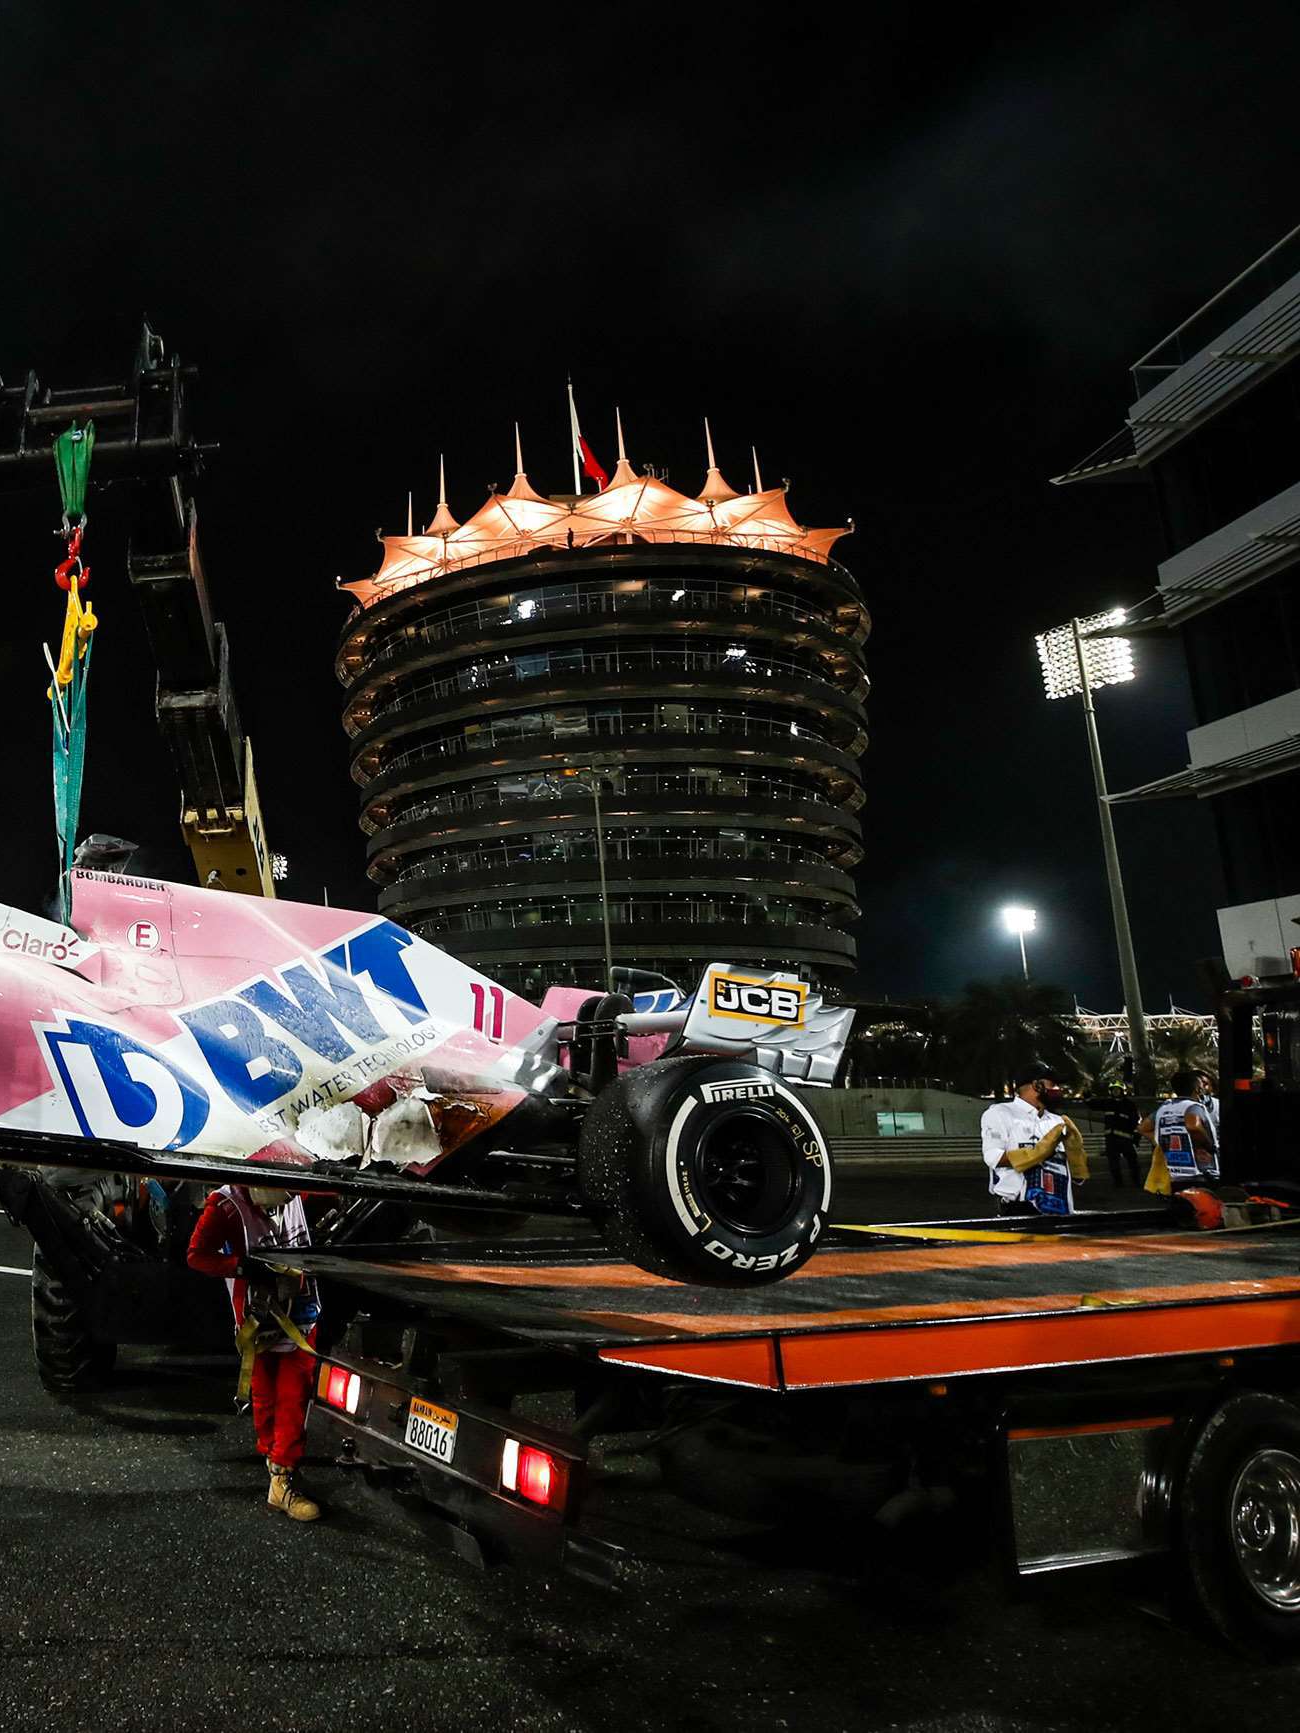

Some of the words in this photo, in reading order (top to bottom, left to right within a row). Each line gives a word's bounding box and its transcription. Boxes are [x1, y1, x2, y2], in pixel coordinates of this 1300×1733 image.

[76, 869, 164, 892] BOMBARDIER
[3, 929, 68, 960] Claro
[135, 924, 150, 948] E
[471, 983, 505, 1040] 11
[717, 983, 798, 1019] JCB
[181, 921, 429, 1115] BWT
[291, 1072, 356, 1114] WATER
[354, 1024, 443, 1078] TECHNOLOGY
[700, 1077, 775, 1104] PIRELLI
[808, 1213, 823, 1245] P
[703, 1239, 800, 1272] ZERO
[410, 1417, 447, 1457] 88016
